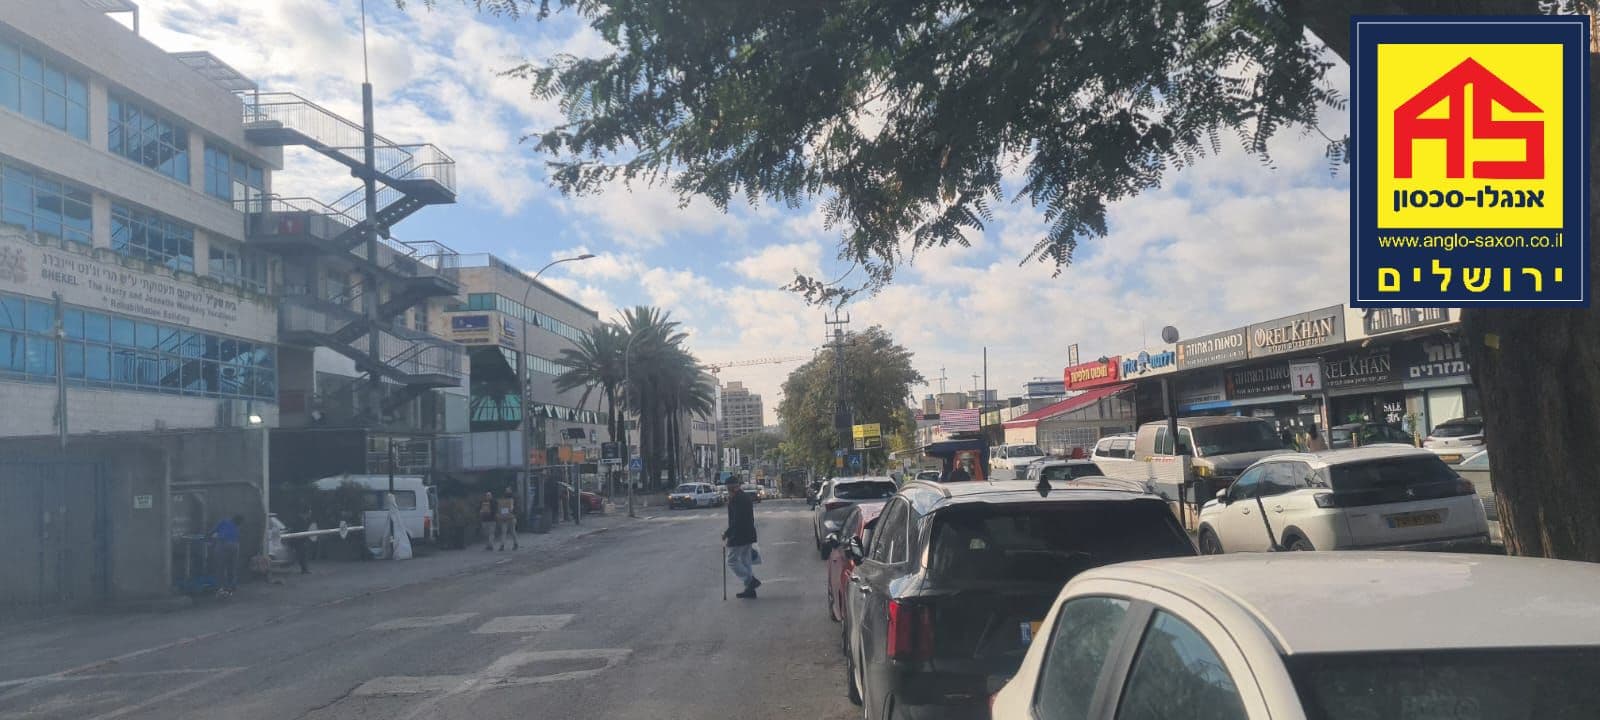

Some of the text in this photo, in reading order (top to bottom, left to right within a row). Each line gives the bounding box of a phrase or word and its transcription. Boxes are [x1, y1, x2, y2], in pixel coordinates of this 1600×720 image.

[1254, 327, 1290, 347] OREL
[1291, 316, 1335, 341] KHAN
[1186, 333, 1243, 357] כסאות האחוזה
[1323, 355, 1391, 379] REL KHAN
[1297, 373, 1315, 388] 14
